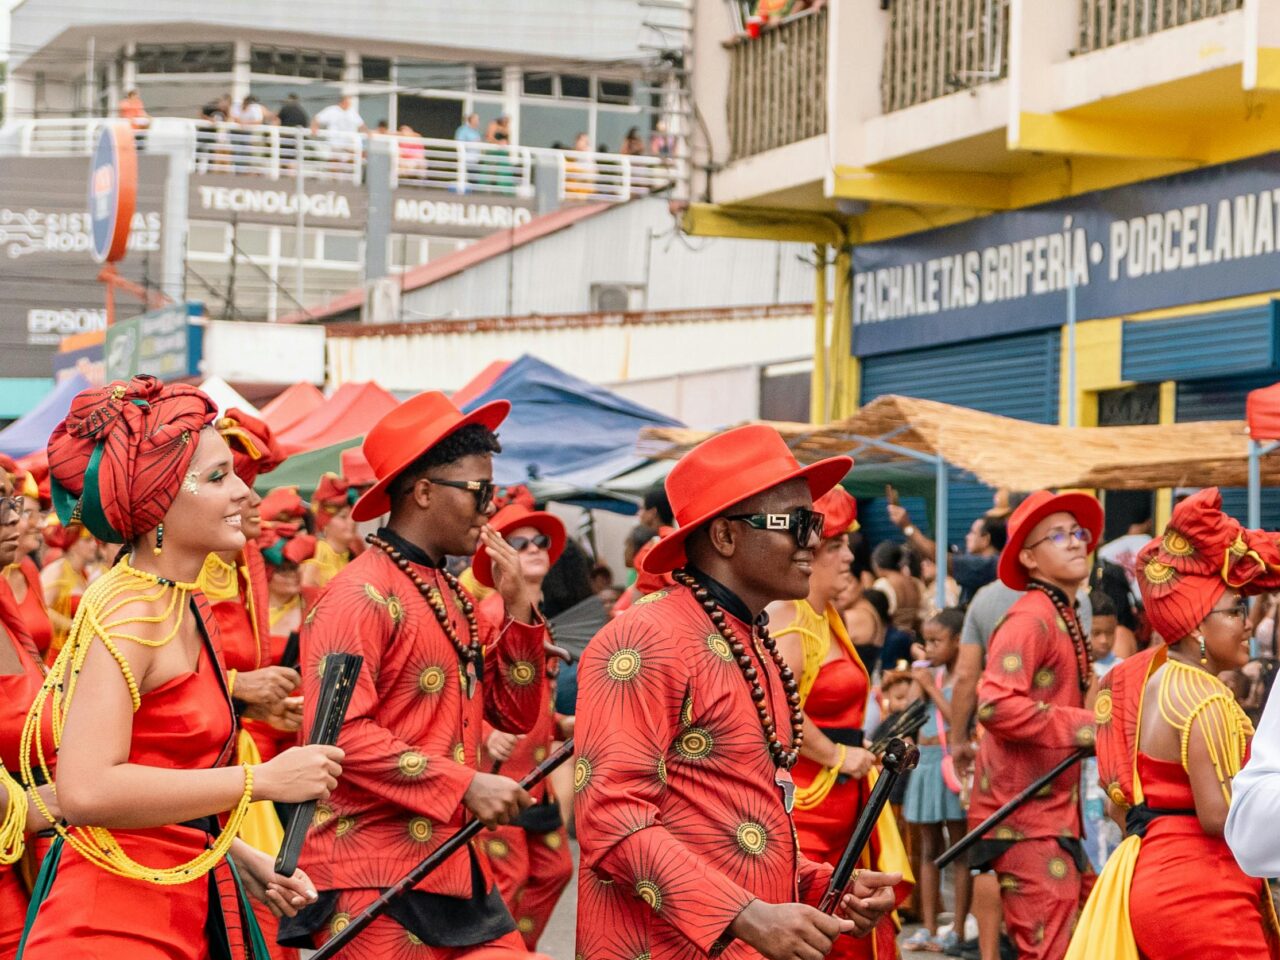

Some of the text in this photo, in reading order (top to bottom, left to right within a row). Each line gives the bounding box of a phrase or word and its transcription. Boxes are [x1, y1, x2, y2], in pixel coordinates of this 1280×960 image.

[199, 184, 351, 219] TECNOLOGÍA
[394, 198, 532, 228] MOBILIARIO
[853, 250, 981, 324] FACHALETAS
[981, 214, 1090, 302] GRIFERÍA
[27, 309, 108, 333] EPSON
